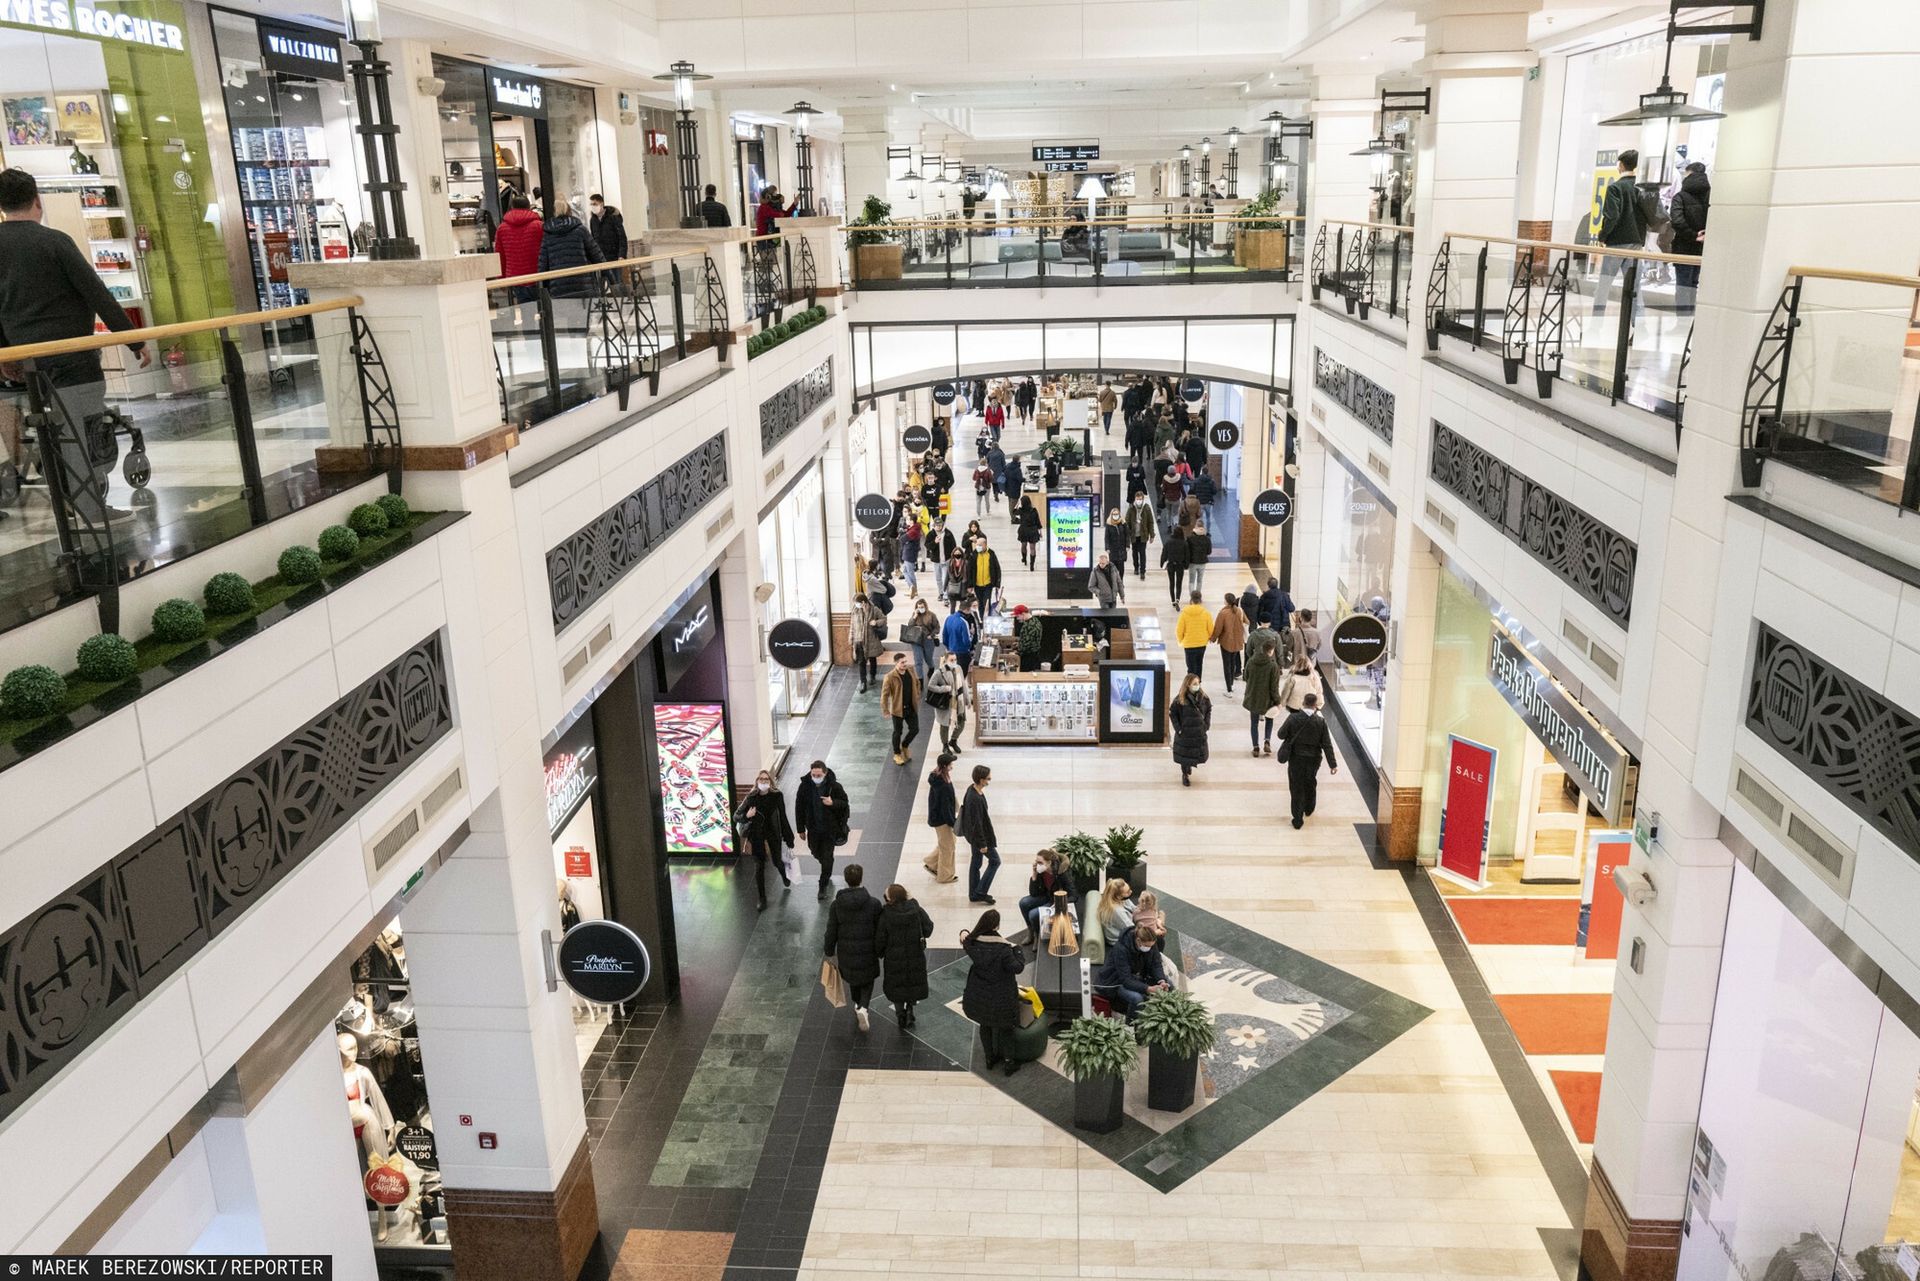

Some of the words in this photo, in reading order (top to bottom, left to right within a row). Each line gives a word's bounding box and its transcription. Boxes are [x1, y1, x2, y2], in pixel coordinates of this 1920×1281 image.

[0, 0, 72, 30] YVES
[75, 7, 184, 50] ROCHER
[1593, 177, 1615, 225] 5
[935, 390, 954, 398] ecco
[1217, 429, 1232, 442] YES
[857, 508, 890, 516] TEILOR
[1057, 545, 1083, 553] People
[674, 604, 708, 653] MAC
[1455, 765, 1485, 784] SALE
[585, 954, 618, 965] Poupée
[584, 963, 623, 971] MARILYN
[407, 1127, 424, 1135] 3+1
[407, 1151, 431, 1160] 11,90
